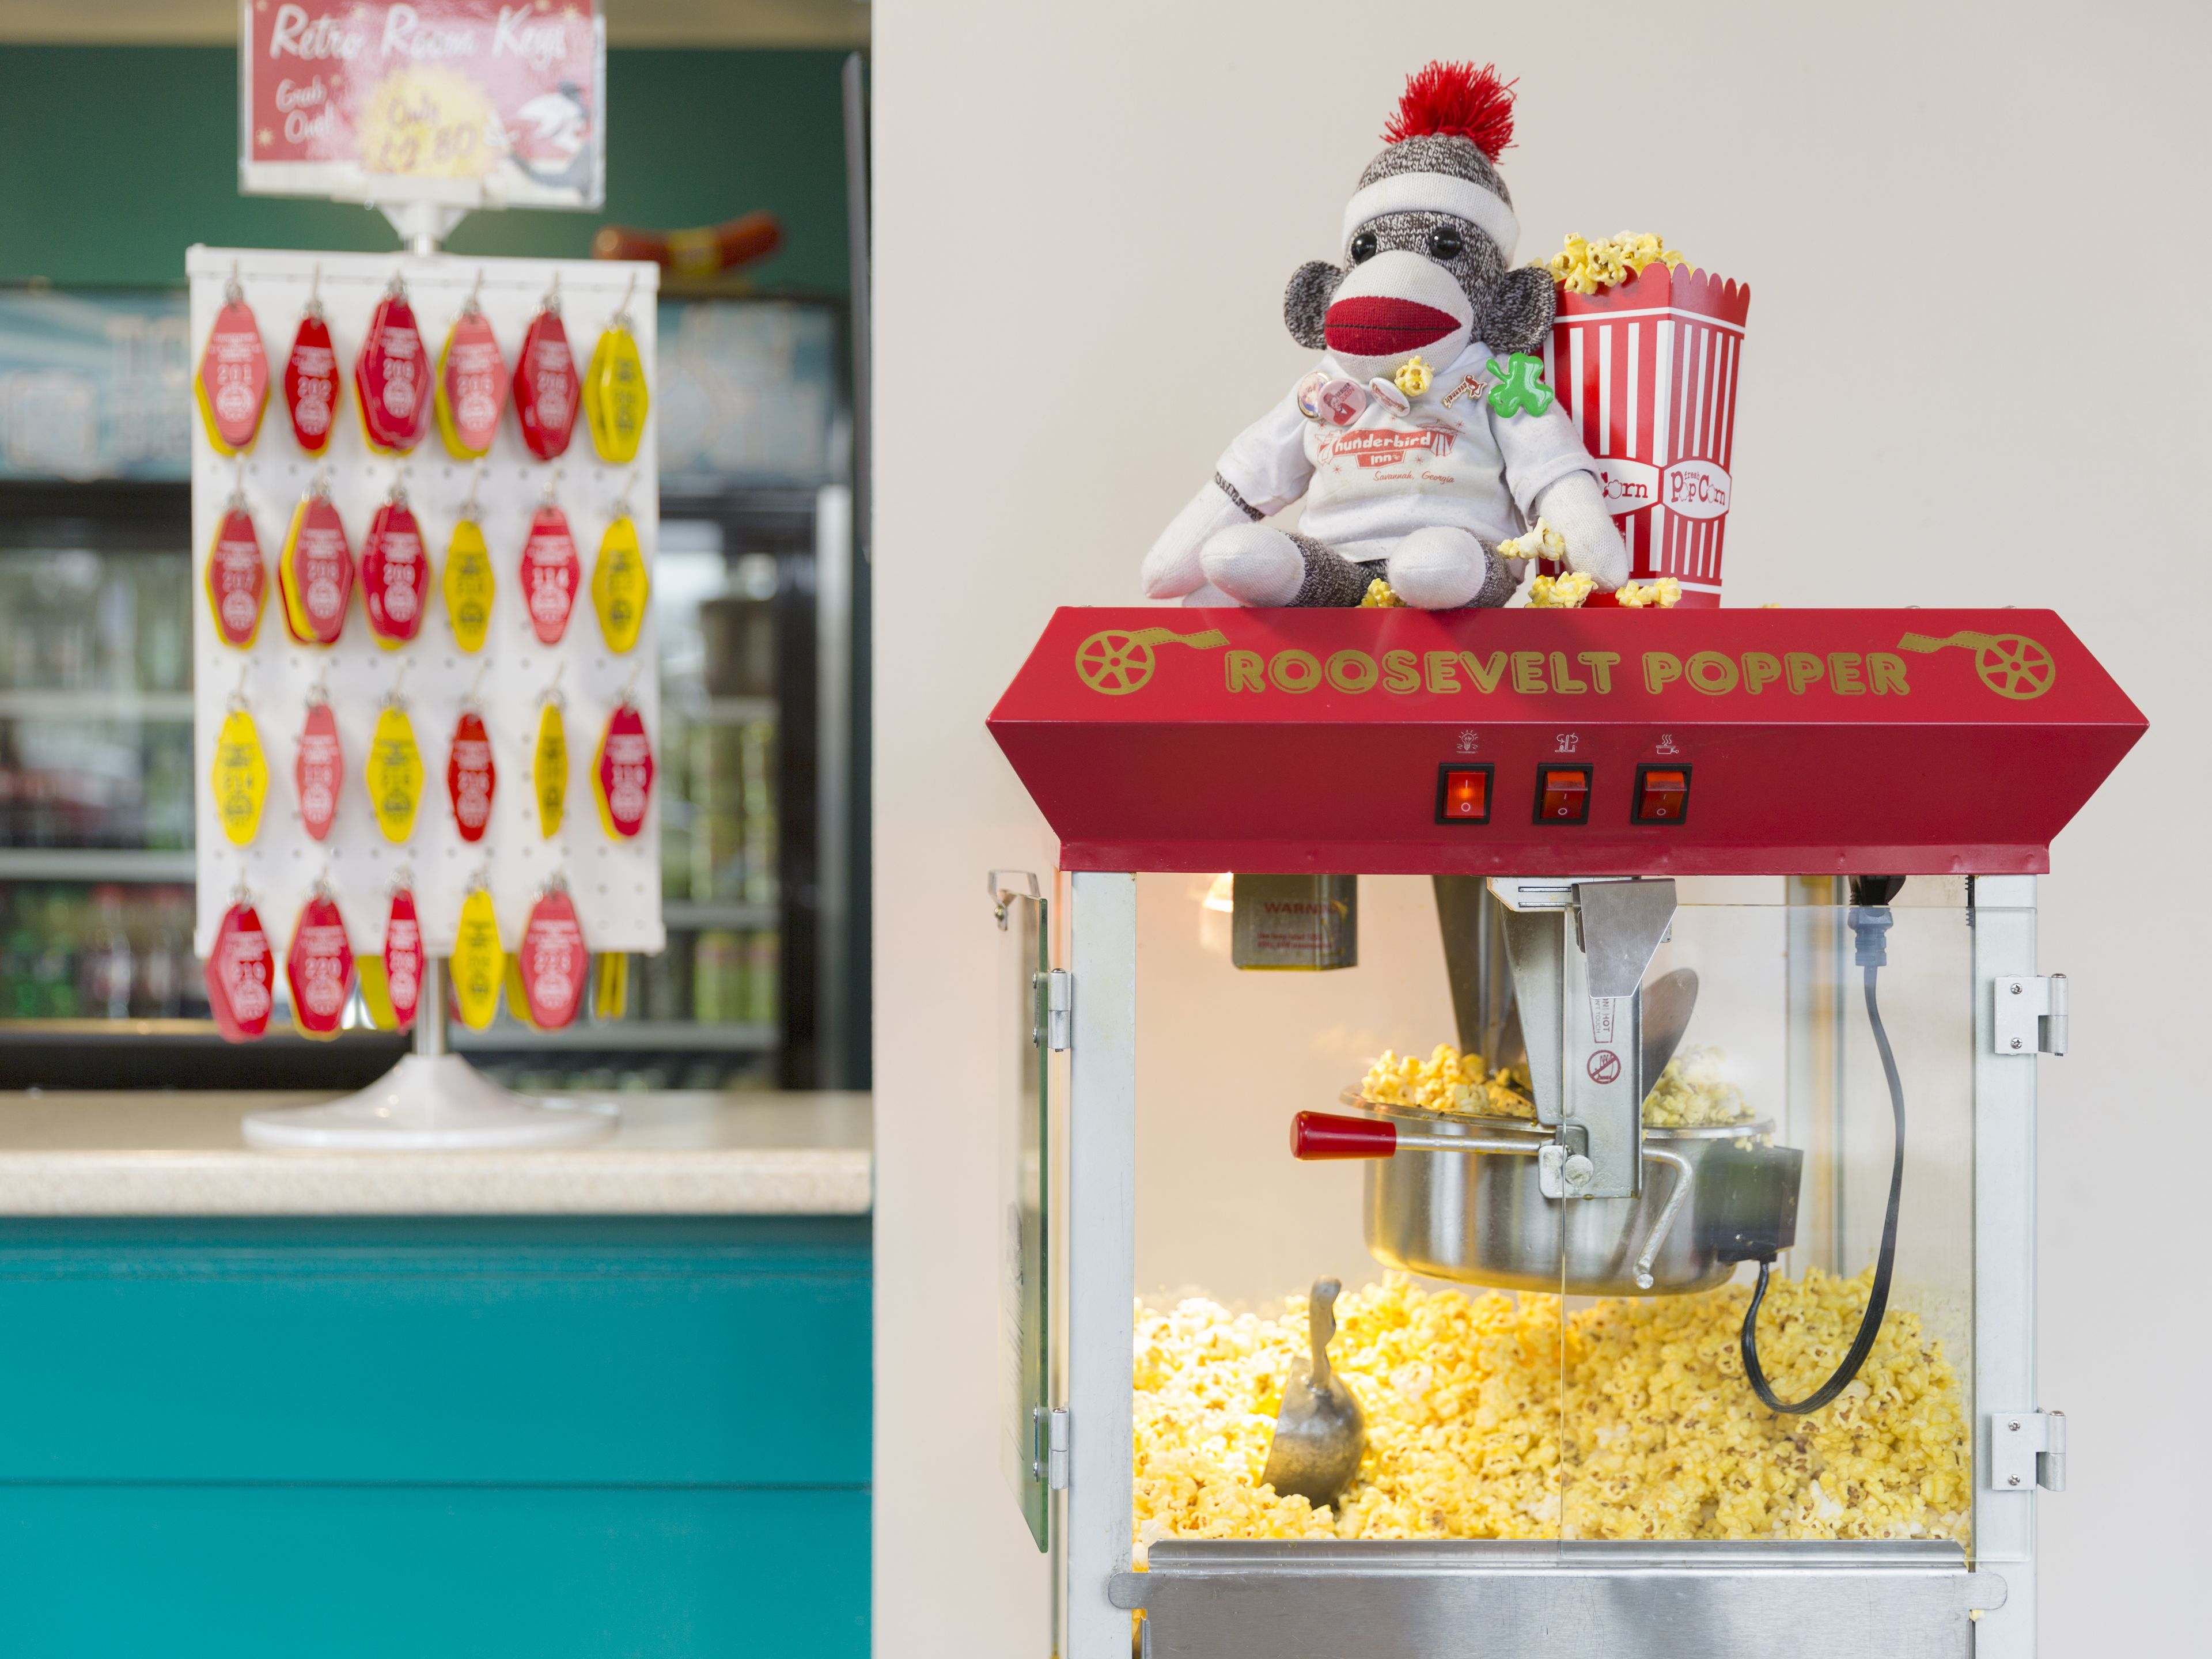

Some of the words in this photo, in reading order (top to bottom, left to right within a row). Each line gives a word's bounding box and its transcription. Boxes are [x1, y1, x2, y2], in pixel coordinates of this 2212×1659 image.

[270, 3, 367, 59] Retro
[381, 3, 478, 58] Room
[491, 5, 566, 70] Keys
[276, 74, 327, 112] Grab
[1340, 388, 1355, 402] QUEEN
[1314, 429, 1431, 466] Thunderbird
[1370, 454, 1392, 465] Inn
[1373, 470, 1415, 482] Savannah,
[1421, 471, 1455, 484] Georgia
[1684, 471, 1699, 480] fresh
[1225, 649, 1620, 695] ROOSEVELT
[1642, 650, 1911, 695] POPPER
